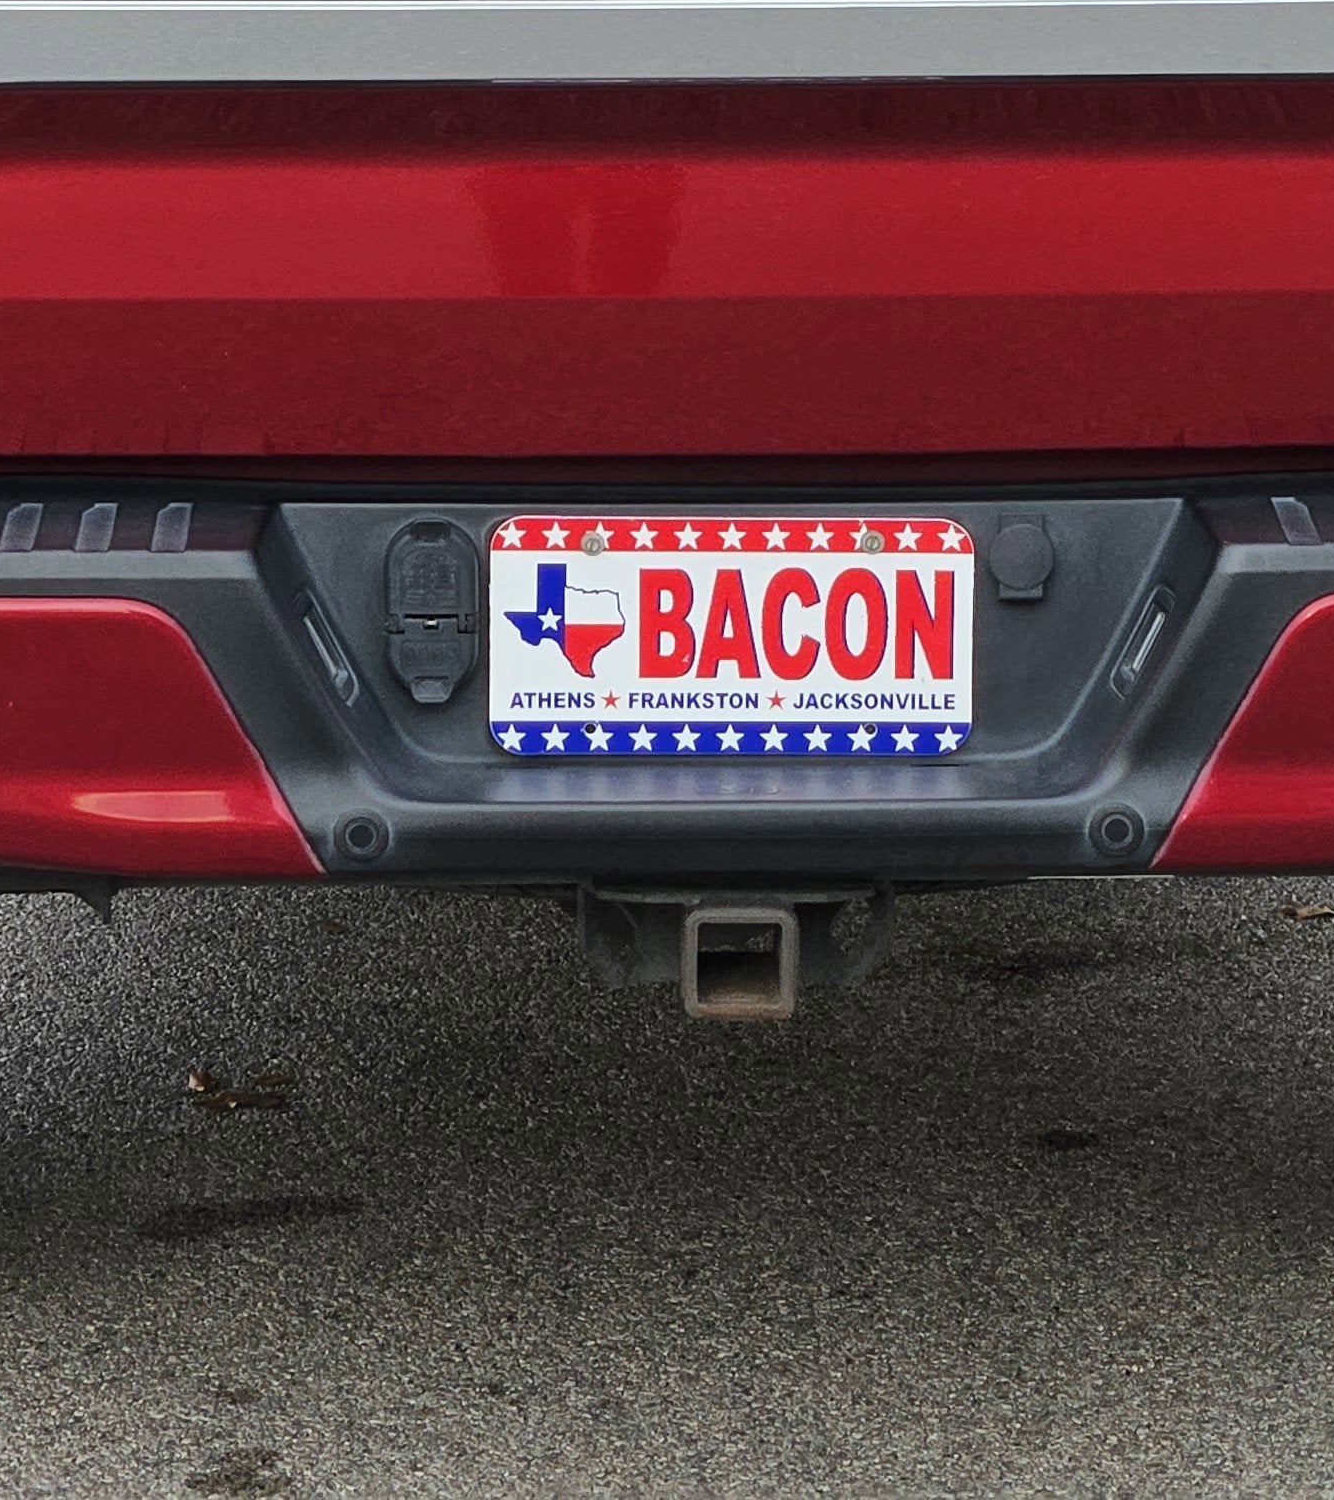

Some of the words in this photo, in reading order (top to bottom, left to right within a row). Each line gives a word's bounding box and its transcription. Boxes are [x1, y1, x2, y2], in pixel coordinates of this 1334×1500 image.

[637, 566, 956, 681] BACON
[509, 691, 597, 711] ATHENS
[627, 691, 760, 711] FRANKSTON
[792, 692, 957, 712] JACKSONVILLE
